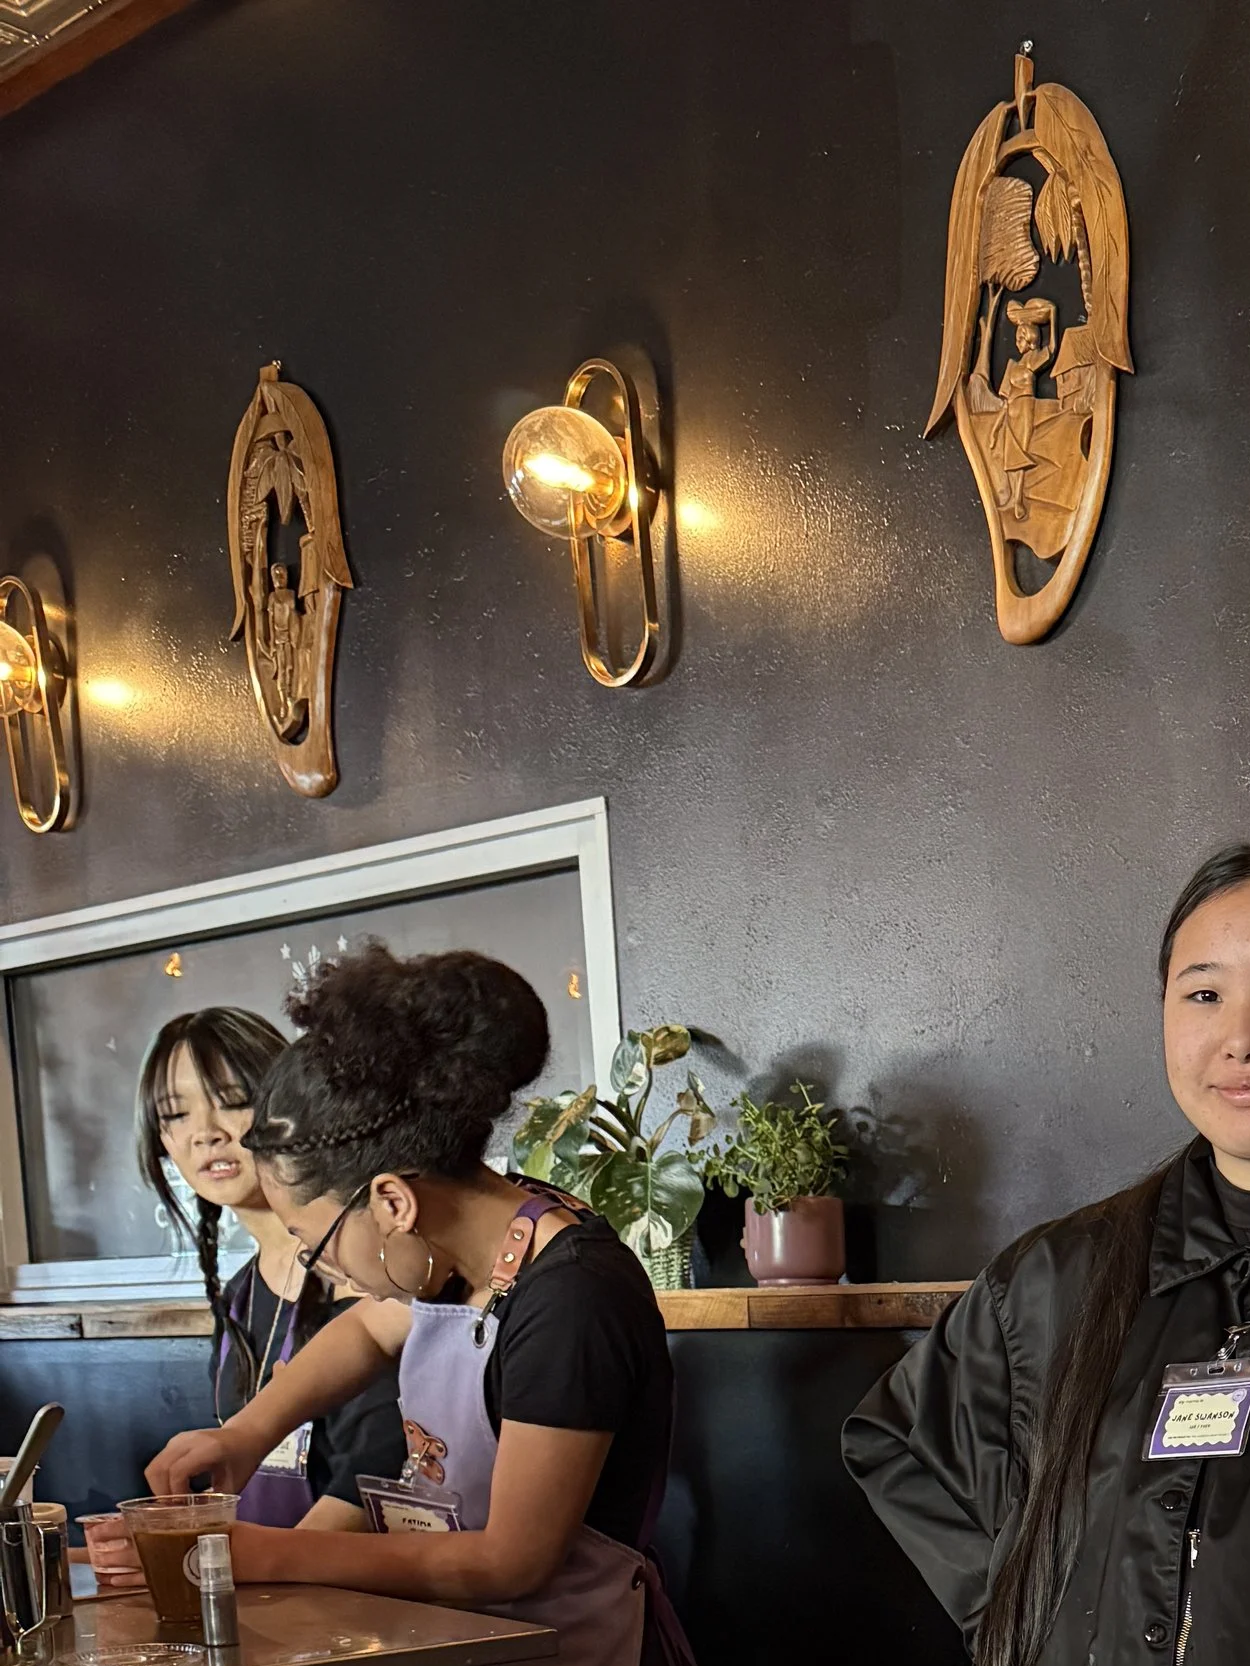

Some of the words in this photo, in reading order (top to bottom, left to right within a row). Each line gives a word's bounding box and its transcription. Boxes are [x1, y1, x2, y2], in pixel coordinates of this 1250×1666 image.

[1172, 1413, 1193, 1422] JANE
[1195, 1410, 1235, 1421] SWANSON
[402, 1517, 432, 1528] FATIMA
